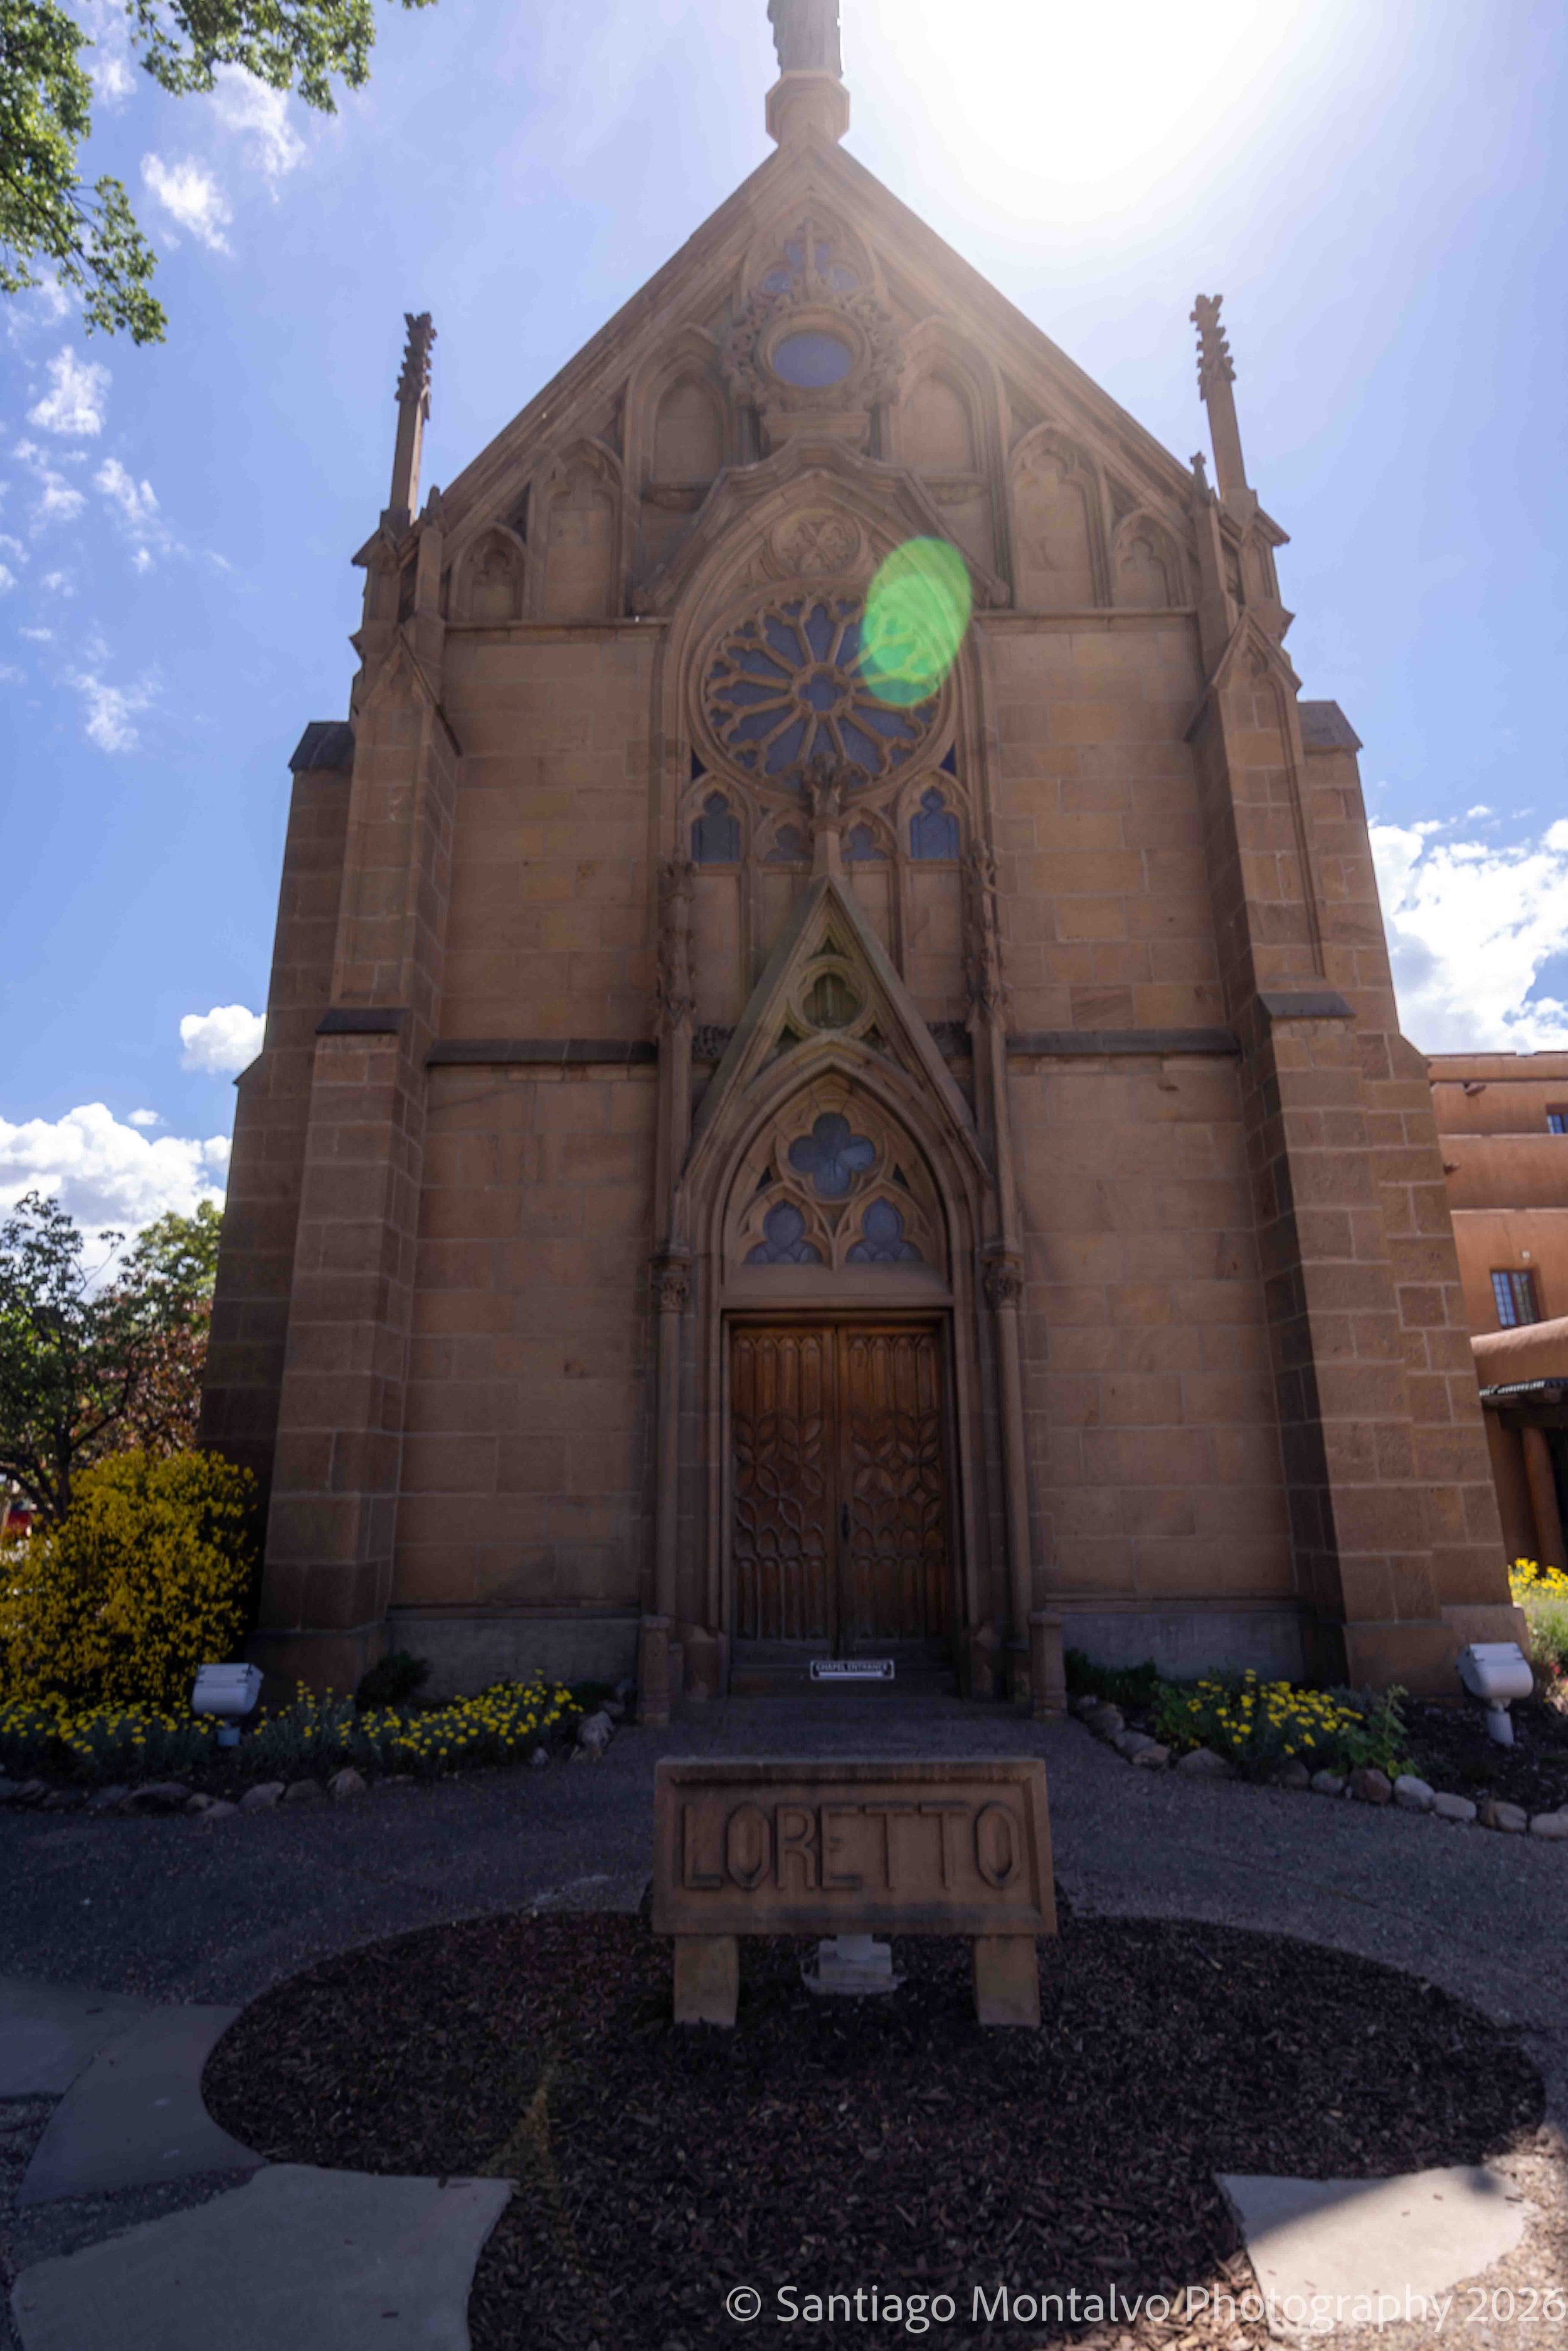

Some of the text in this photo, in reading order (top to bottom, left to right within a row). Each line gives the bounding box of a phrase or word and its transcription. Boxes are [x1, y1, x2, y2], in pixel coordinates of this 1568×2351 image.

[816, 1662, 887, 1671] CHAPEL ENTRANCE
[682, 1800, 1021, 1891] LORETTO
